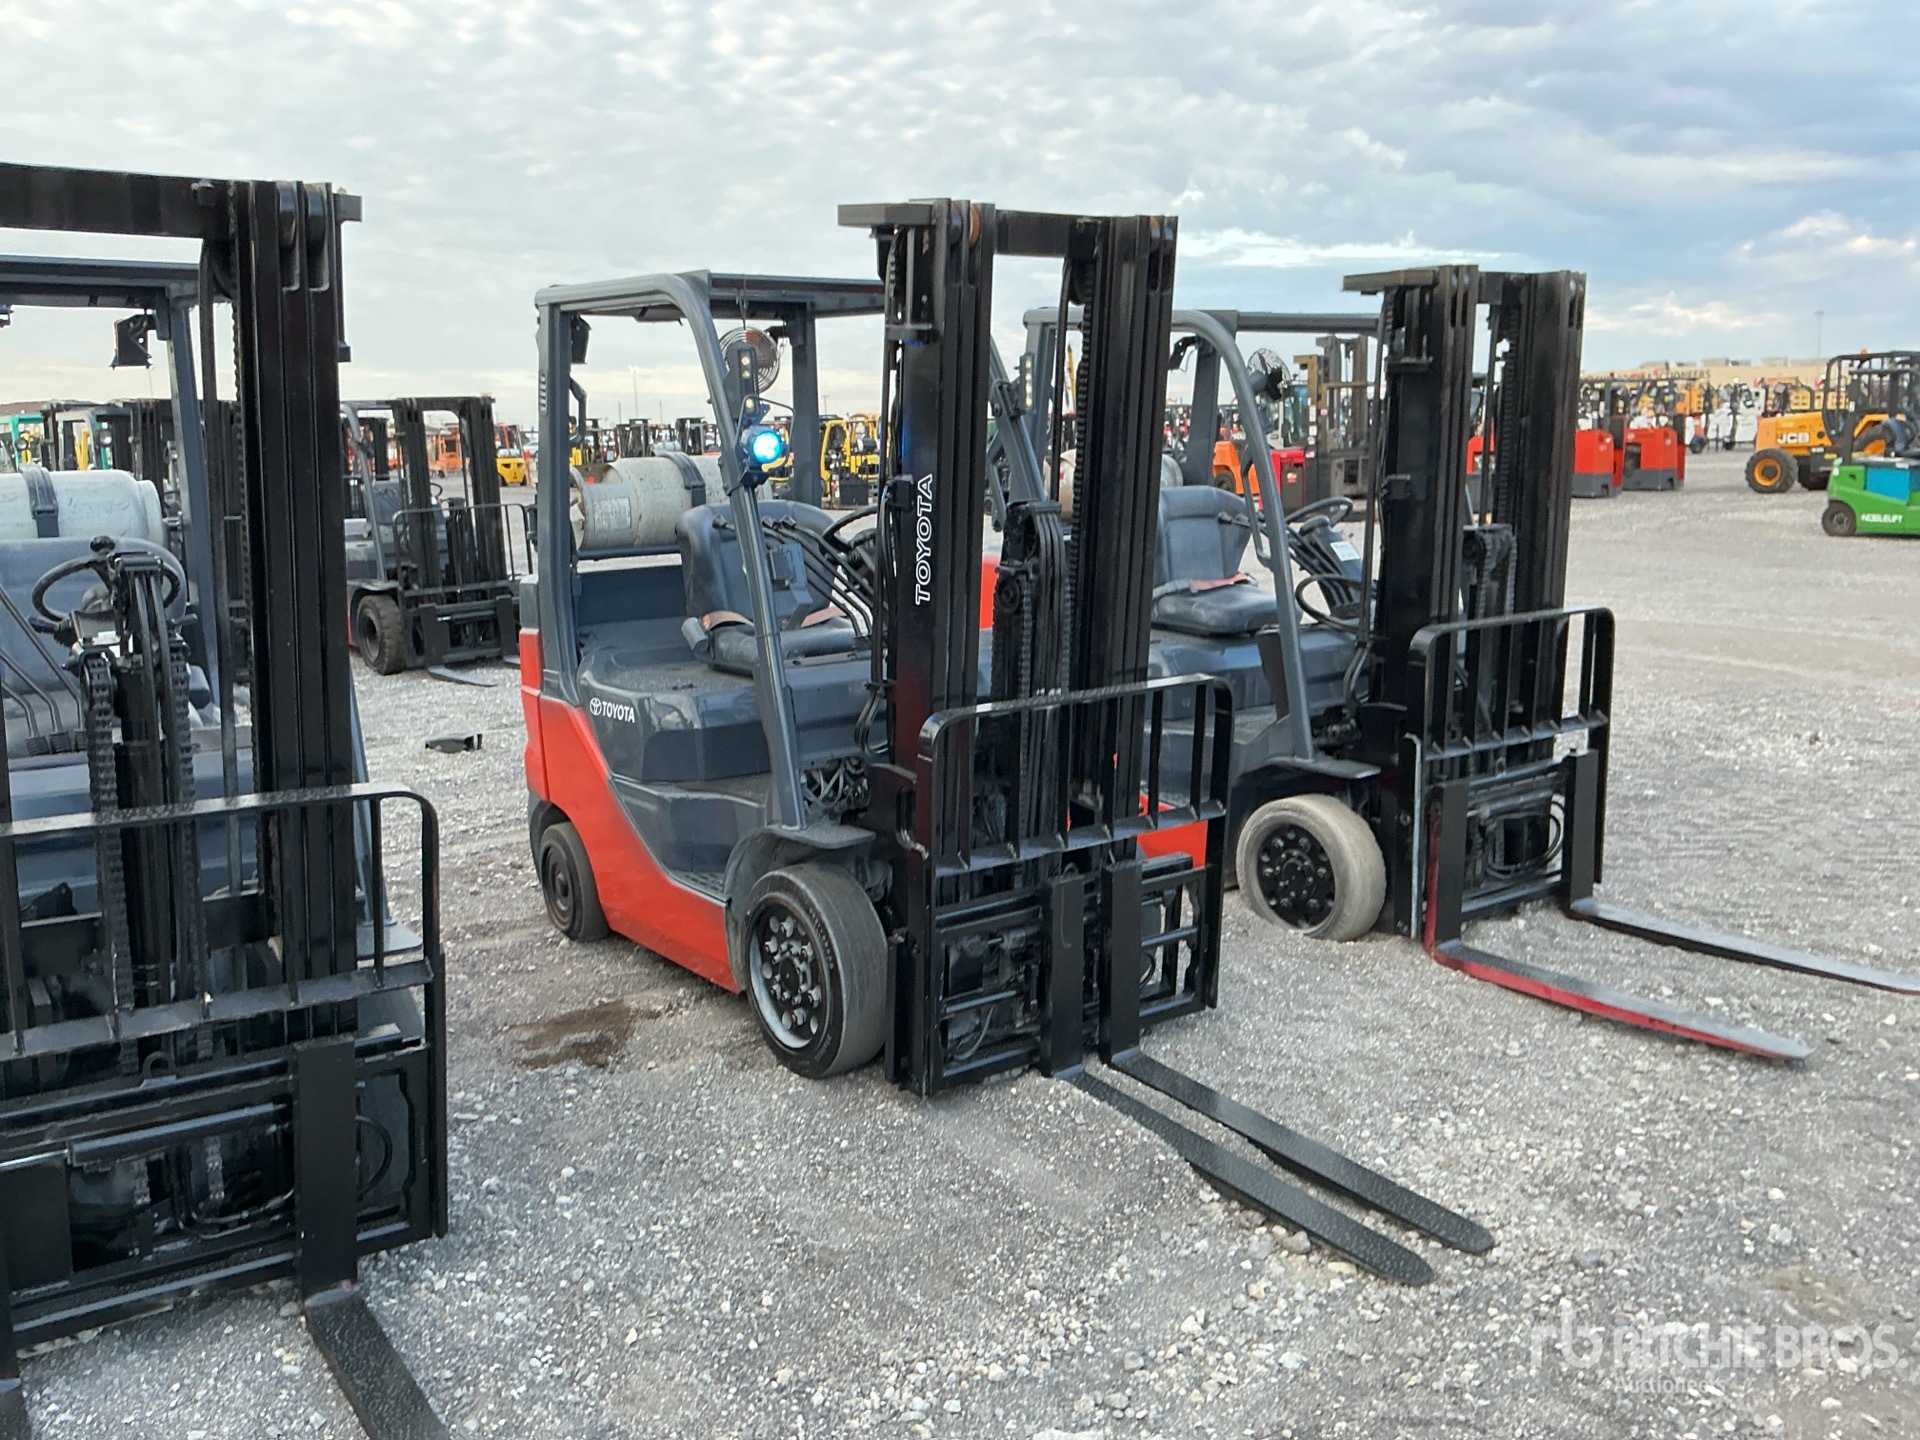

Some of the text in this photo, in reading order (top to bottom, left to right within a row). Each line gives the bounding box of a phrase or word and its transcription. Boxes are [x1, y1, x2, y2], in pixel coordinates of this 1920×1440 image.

[1777, 432, 1809, 444] JCB
[915, 474, 932, 605] TOYOTA
[602, 701, 635, 723] TOYOTA
